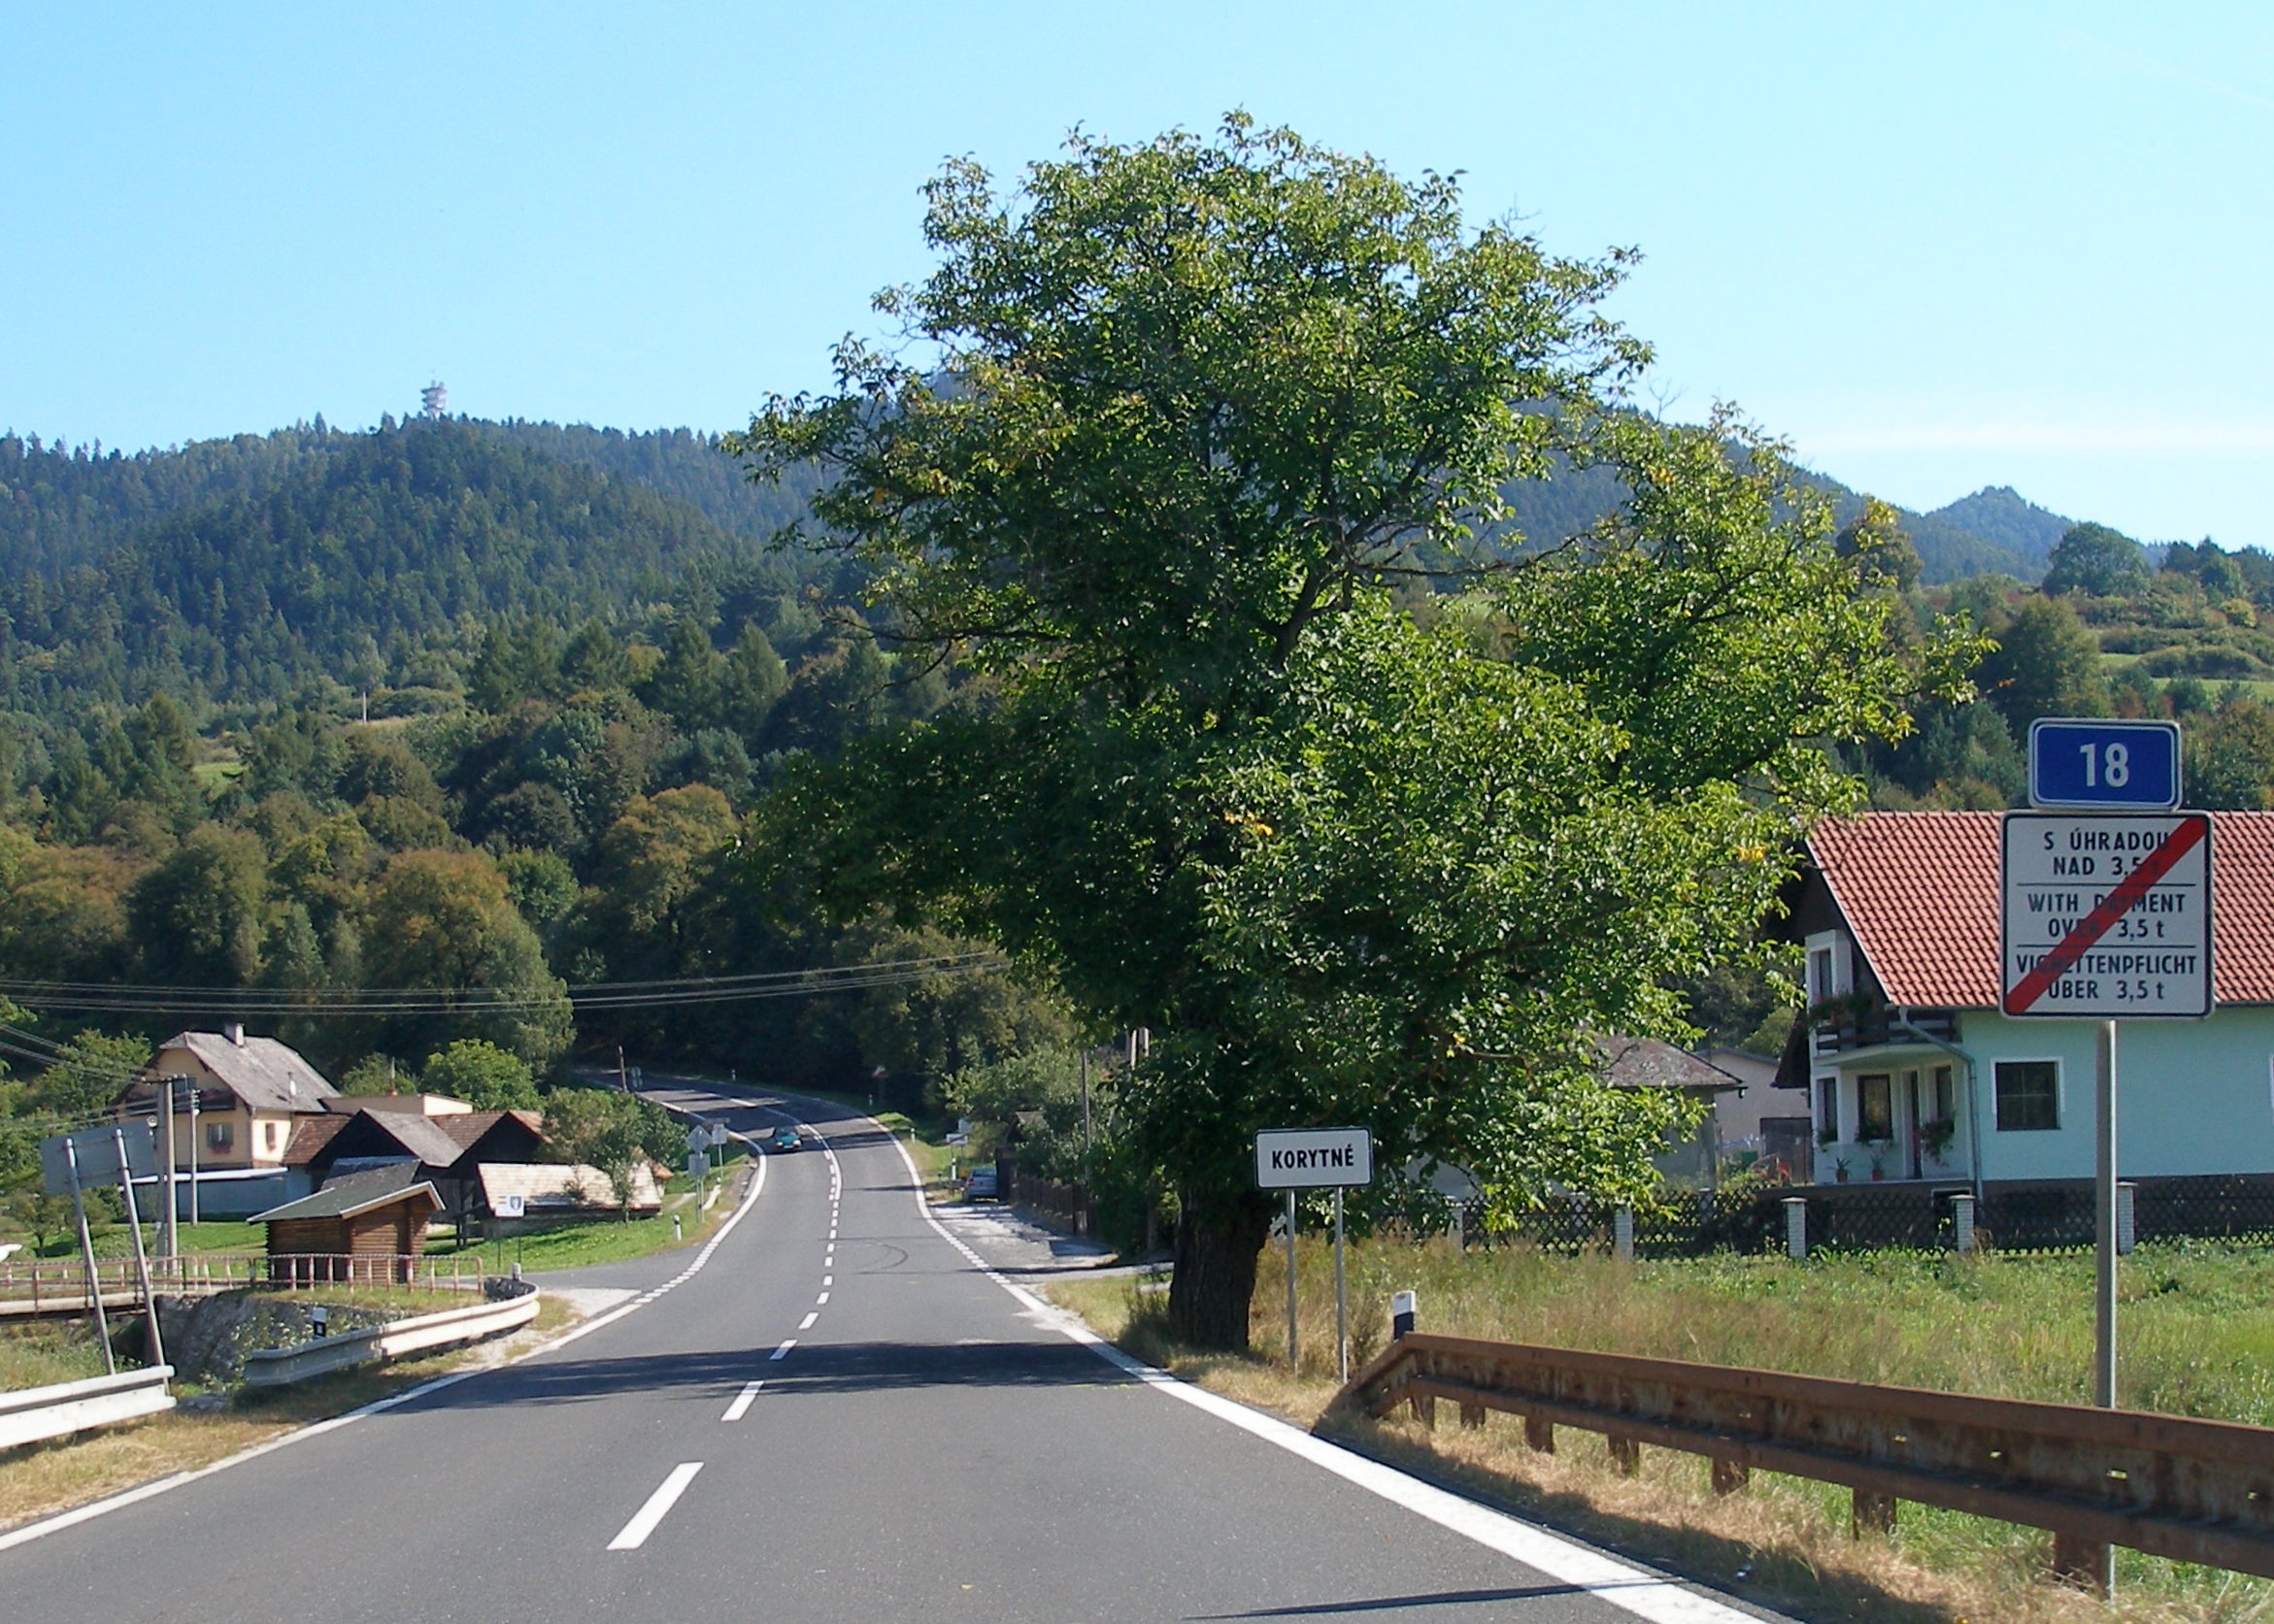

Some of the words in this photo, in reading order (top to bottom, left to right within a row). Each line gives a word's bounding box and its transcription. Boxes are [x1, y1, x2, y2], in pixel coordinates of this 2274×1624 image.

[2080, 743, 2129, 787] 18
[2044, 832, 2055, 850] S
[2069, 827, 2170, 851] ÚHRADOU
[2054, 856, 2095, 876] NAD
[2027, 893, 2079, 912] WITH
[2093, 893, 2187, 912] PMENT
[2048, 918, 2099, 939] OV
[2117, 918, 2149, 941] 3,5
[2156, 920, 2165, 939] t
[2017, 954, 2197, 976] VITTENPFLICHT
[2116, 979, 2149, 1002] 3,5
[2156, 982, 2165, 1000] t
[1271, 1143, 1354, 1170] KORYTNÉ
